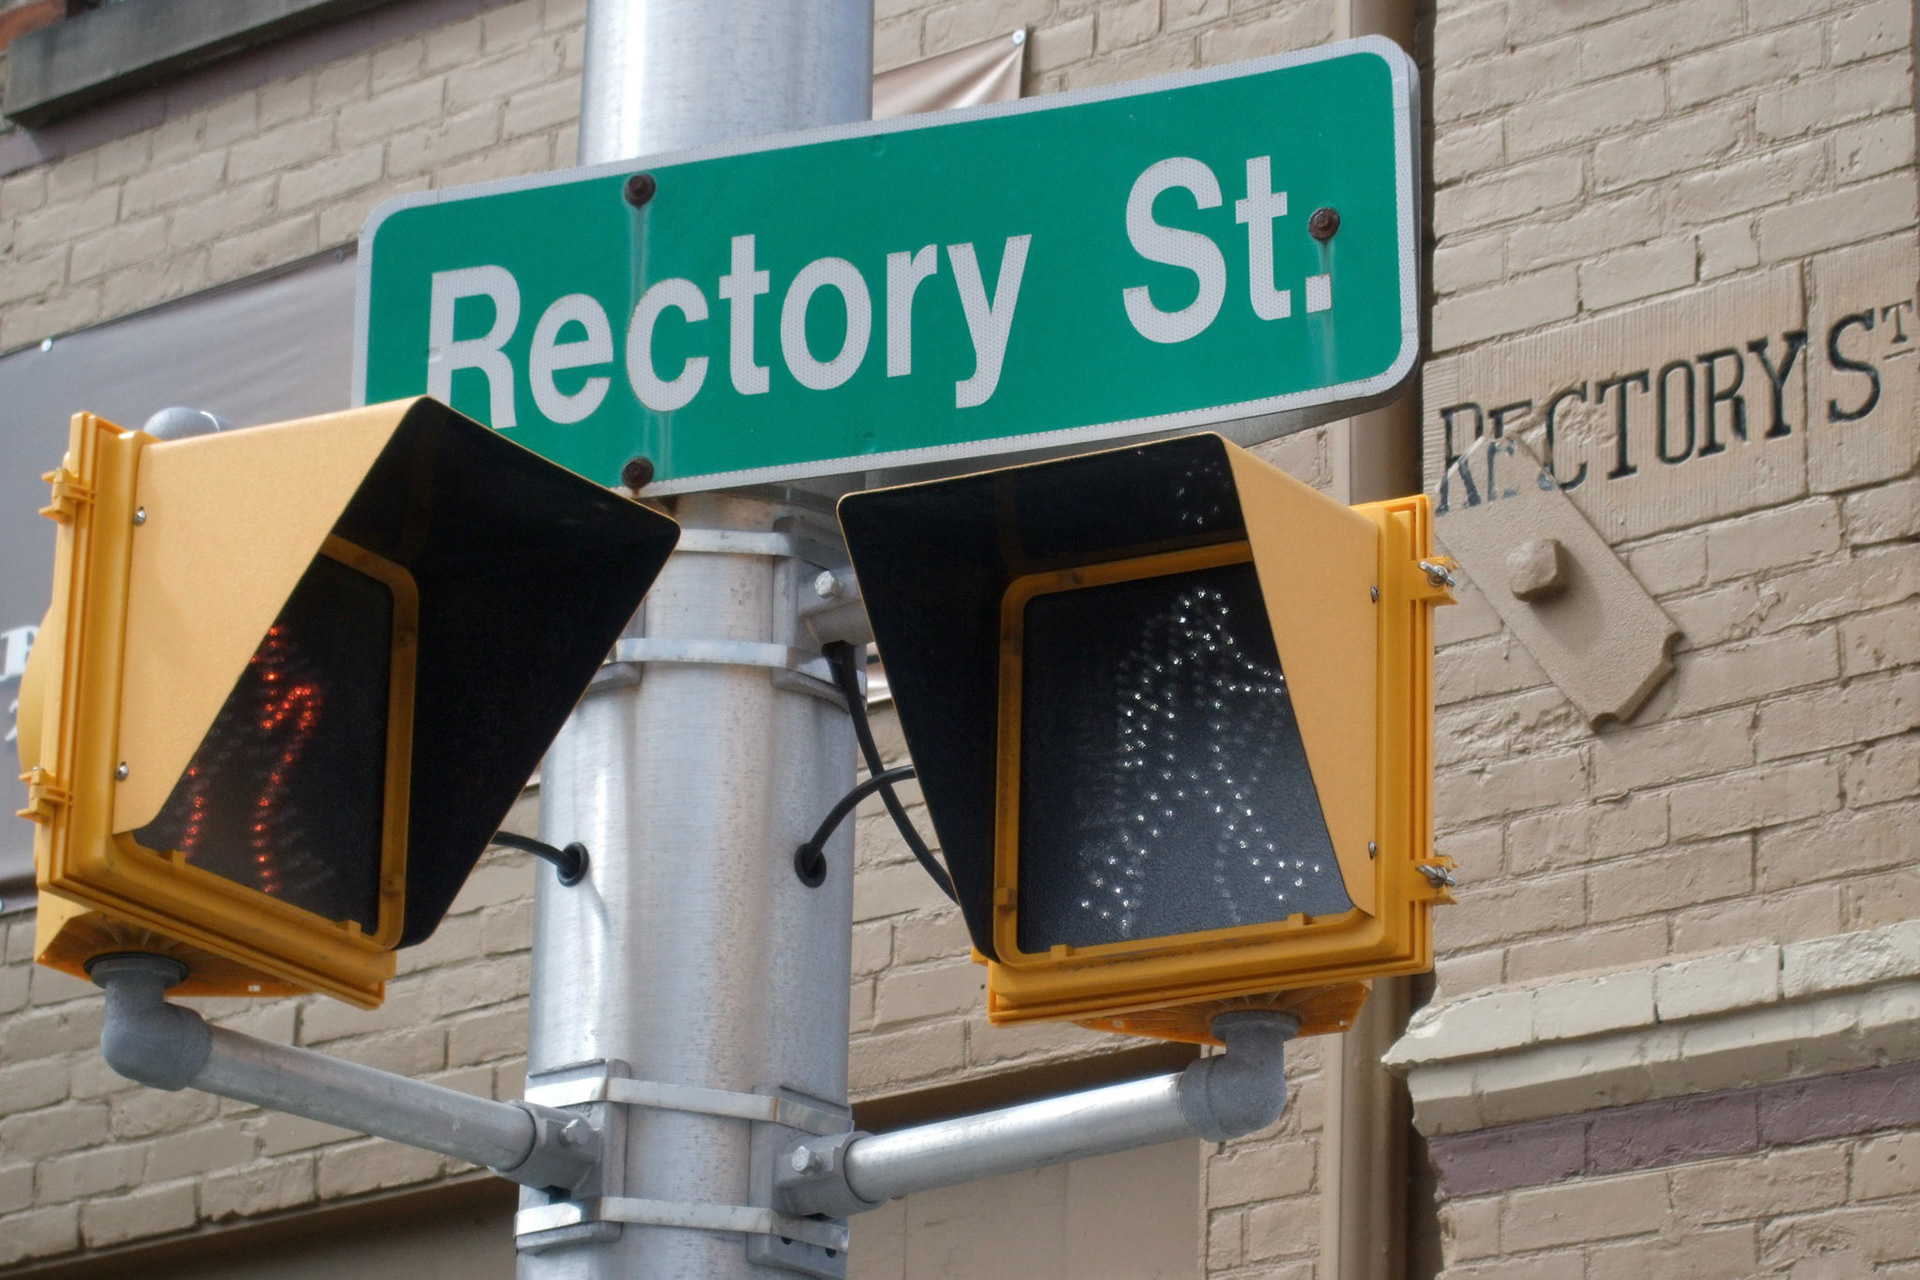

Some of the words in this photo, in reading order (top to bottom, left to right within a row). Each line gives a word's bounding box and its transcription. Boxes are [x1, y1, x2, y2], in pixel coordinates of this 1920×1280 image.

[427, 234, 1032, 429] Rectory
[1123, 155, 1332, 343] St.
[1435, 331, 1807, 517] RECTORY
